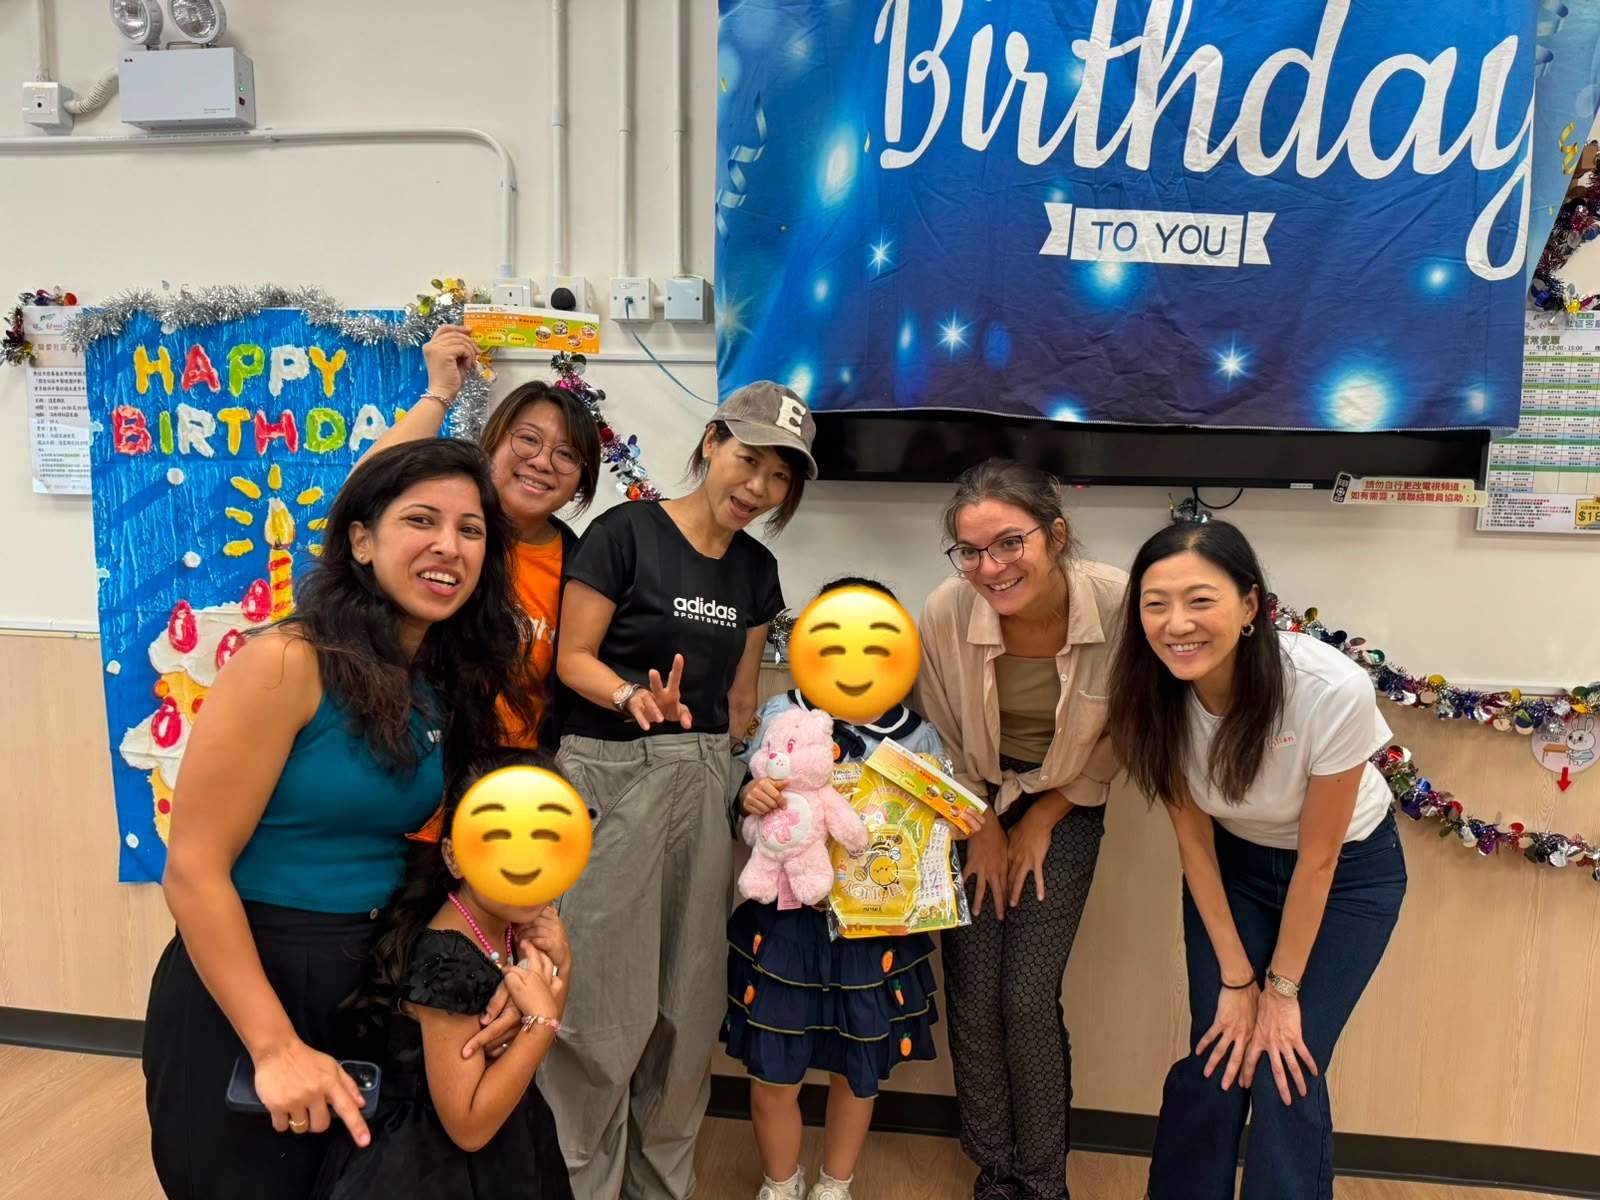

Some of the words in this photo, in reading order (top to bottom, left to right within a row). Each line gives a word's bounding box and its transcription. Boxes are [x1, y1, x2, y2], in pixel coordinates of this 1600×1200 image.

[874, 0, 1535, 281] Birthday
[1091, 221, 1137, 252] TO
[1156, 222, 1227, 256] YOU
[133, 343, 347, 397] HAPPY
[112, 403, 408, 457] BIRTHDA
[775, 395, 807, 437] E
[673, 597, 737, 621] adidas
[673, 610, 737, 629] SPORTSWEAR
